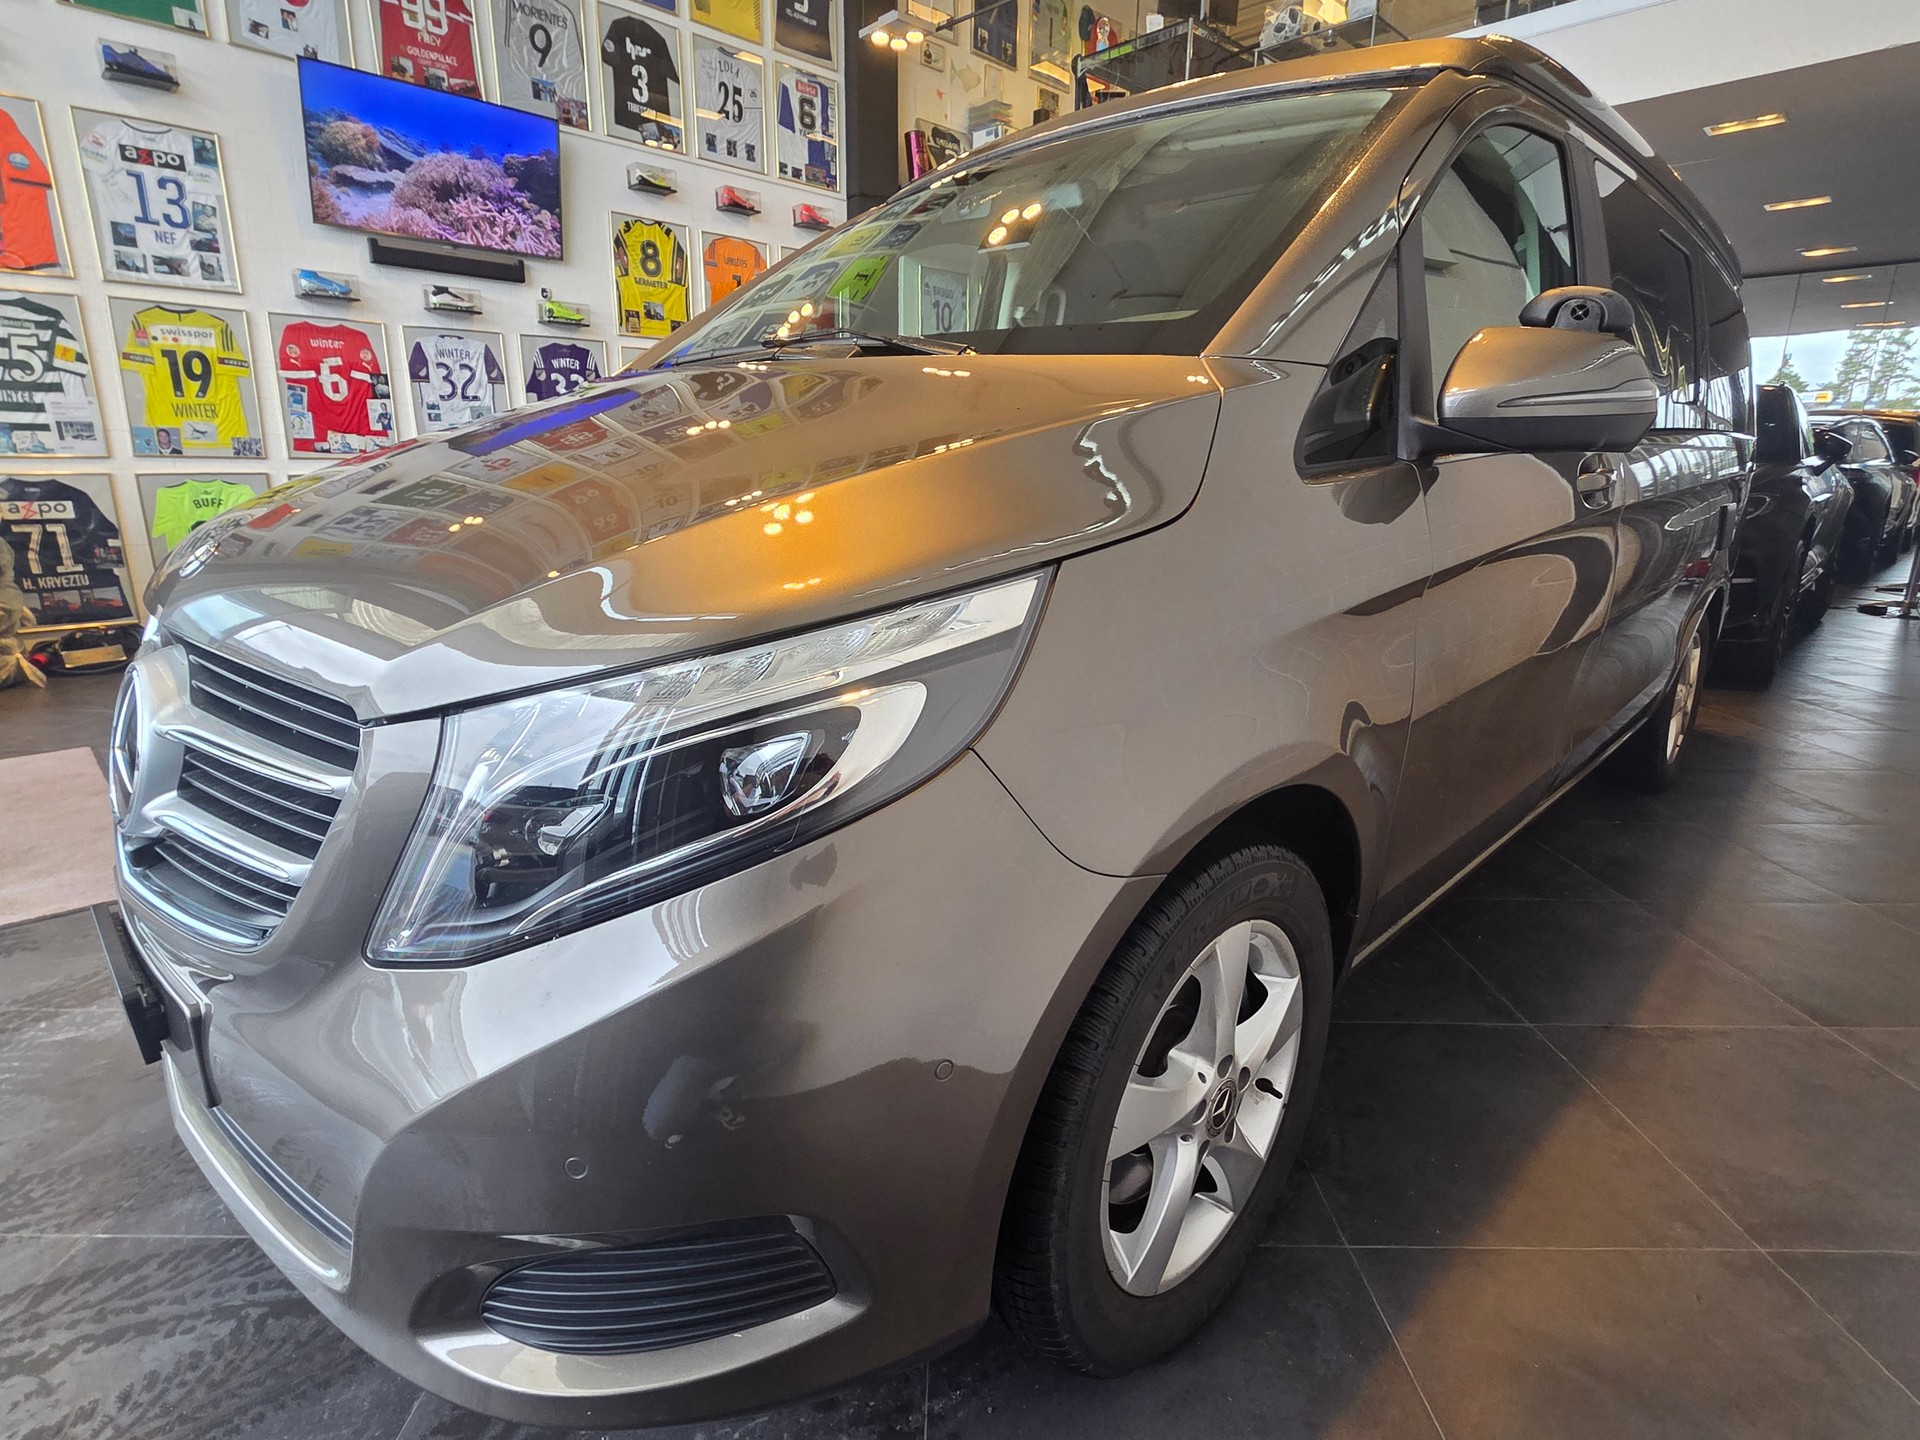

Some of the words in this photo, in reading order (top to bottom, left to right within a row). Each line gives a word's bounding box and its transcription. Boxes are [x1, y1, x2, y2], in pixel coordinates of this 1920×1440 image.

[529, 23, 552, 68] 9
[631, 64, 650, 104] 3
[717, 81, 744, 123] 25
[799, 95, 817, 131] 6
[126, 169, 190, 229] 13
[154, 230, 177, 246] NEF
[639, 239, 662, 277] 8
[932, 299, 952, 332] 10
[309, 338, 344, 349] winter
[437, 348, 471, 361] WINTER
[160, 349, 212, 398] 19
[318, 356, 348, 402] 6
[435, 361, 481, 401] 32
[551, 357, 580, 371] WINTER
[171, 402, 219, 419] WINTER
[192, 497, 224, 509] BUFF
[11, 523, 84, 575] 71
[38, 573, 90, 590] KRYEZIU
